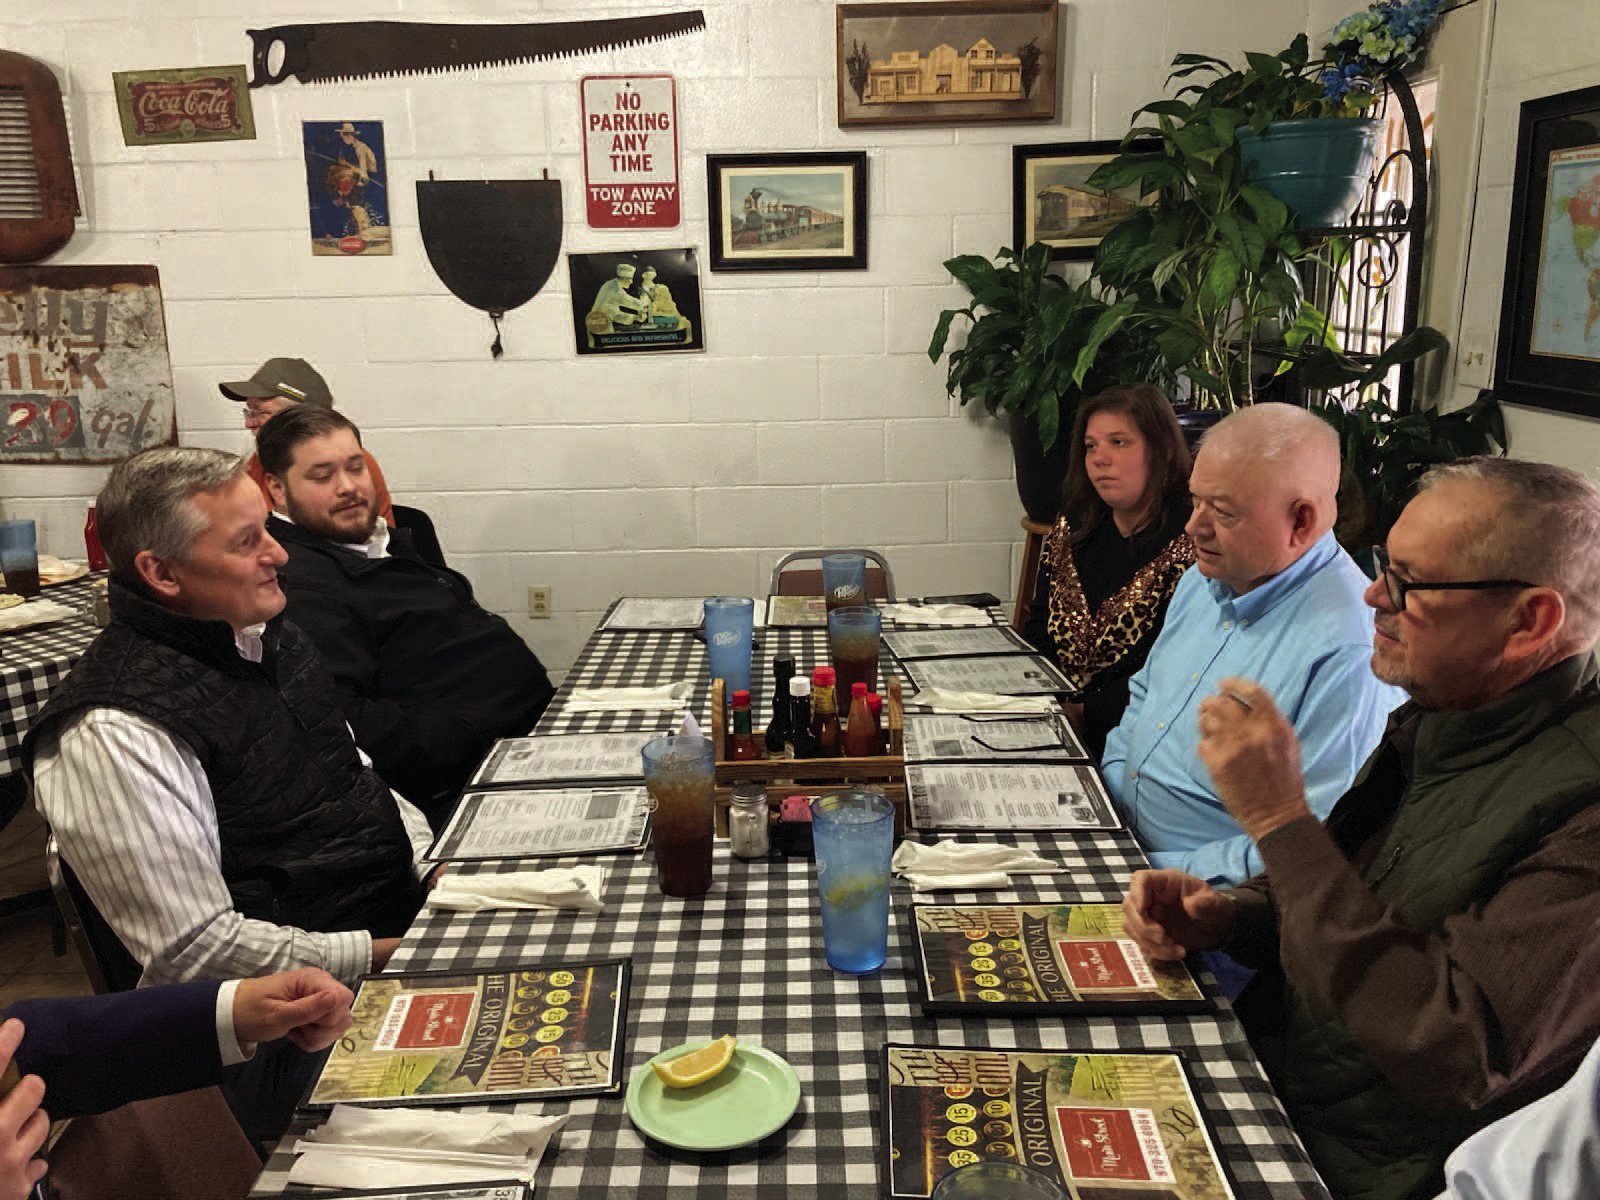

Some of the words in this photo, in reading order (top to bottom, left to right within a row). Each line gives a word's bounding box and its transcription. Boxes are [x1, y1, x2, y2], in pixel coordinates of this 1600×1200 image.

[138, 87, 230, 117] Coca-Cola
[615, 92, 642, 111] NO
[143, 118, 157, 132] 5
[220, 113, 232, 128] 5
[589, 113, 671, 132] PARKING
[611, 133, 649, 153] ANY
[609, 154, 653, 173] TIME
[590, 186, 625, 202] TOW
[631, 185, 676, 201] AWAY
[611, 201, 657, 216] ZONE
[0, 352, 108, 389] ILK
[1027, 920, 1060, 983] ORIGINAL
[981, 975, 994, 985] 35
[461, 998, 503, 1072] ORIGINAL
[542, 1028, 559, 1039] 15
[953, 1107, 969, 1119] 15
[989, 1103, 1004, 1114] 10
[1017, 1076, 1054, 1168] ORIGINAL
[1089, 1117, 1112, 1144] Street
[953, 1129, 970, 1143] 25
[1100, 1144, 1121, 1172] Main
